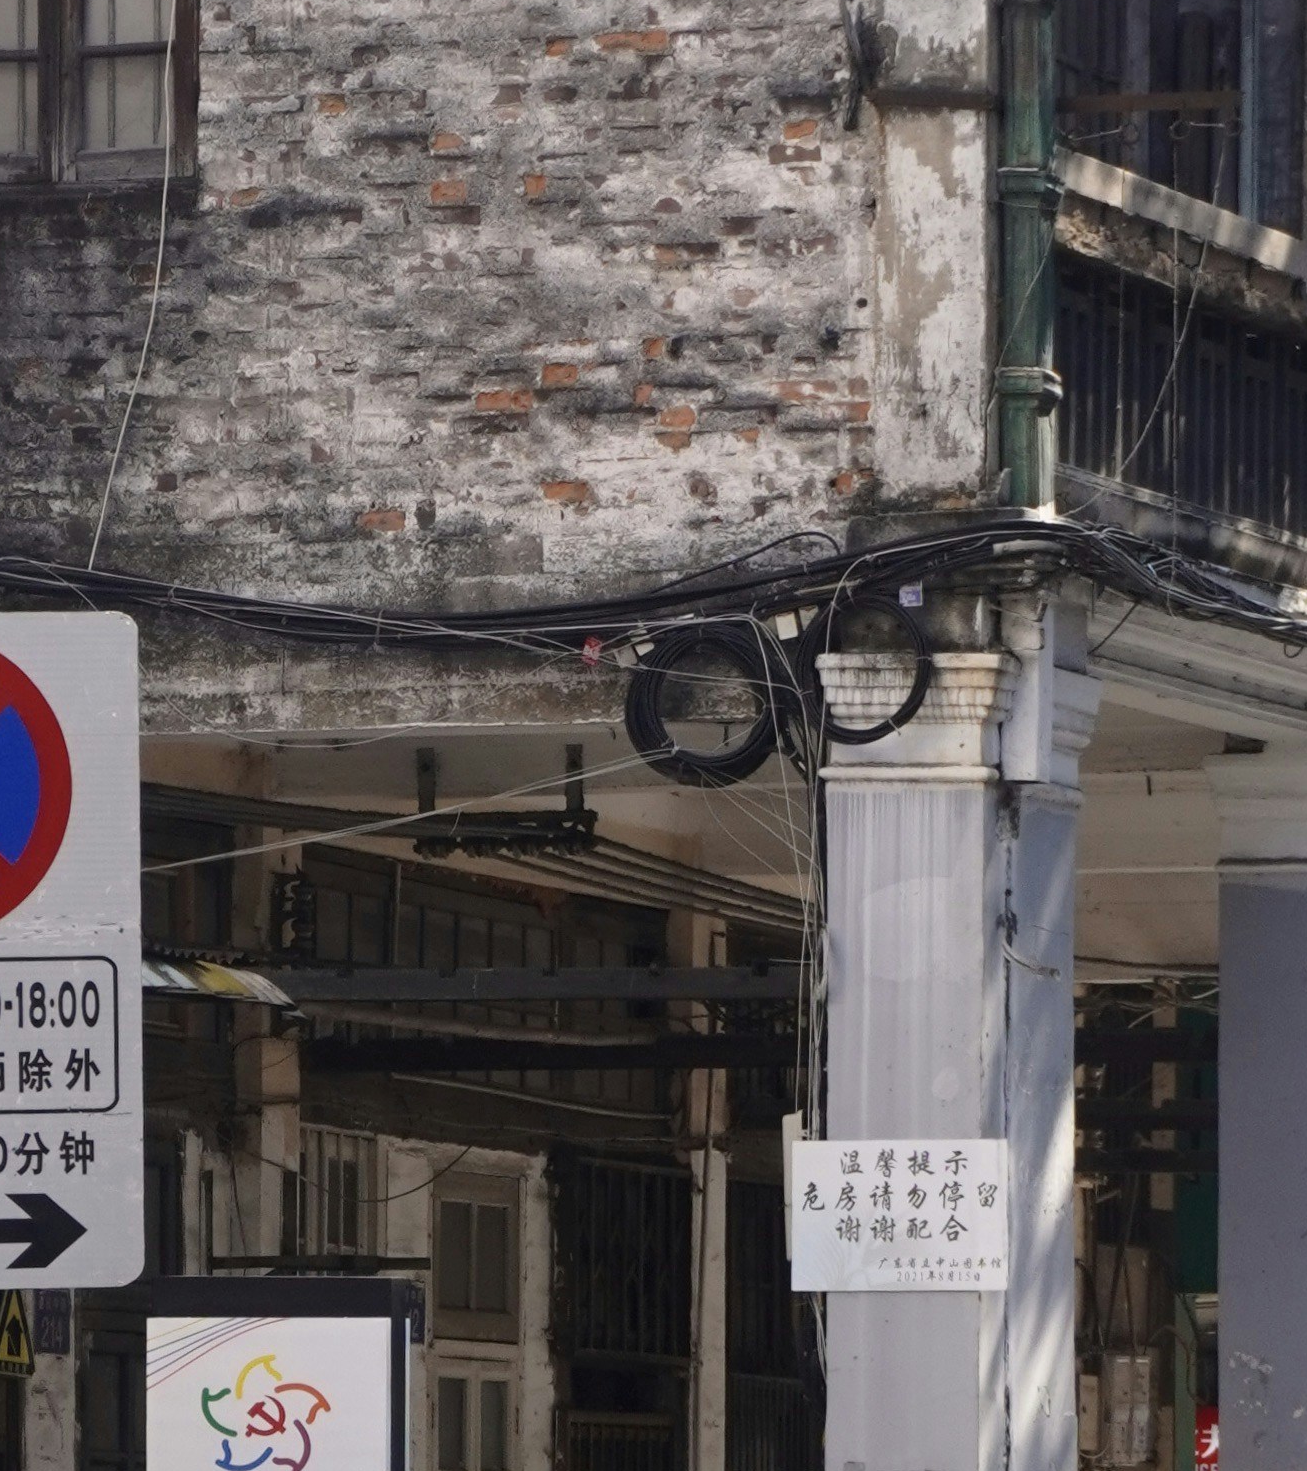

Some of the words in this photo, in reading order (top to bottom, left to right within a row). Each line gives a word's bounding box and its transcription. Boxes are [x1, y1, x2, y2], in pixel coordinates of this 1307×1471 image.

[839, 1148, 968, 1179] 温馨提示
[801, 1181, 998, 1212] 危房请勿停留
[835, 1215, 968, 1243] 谢谢配合
